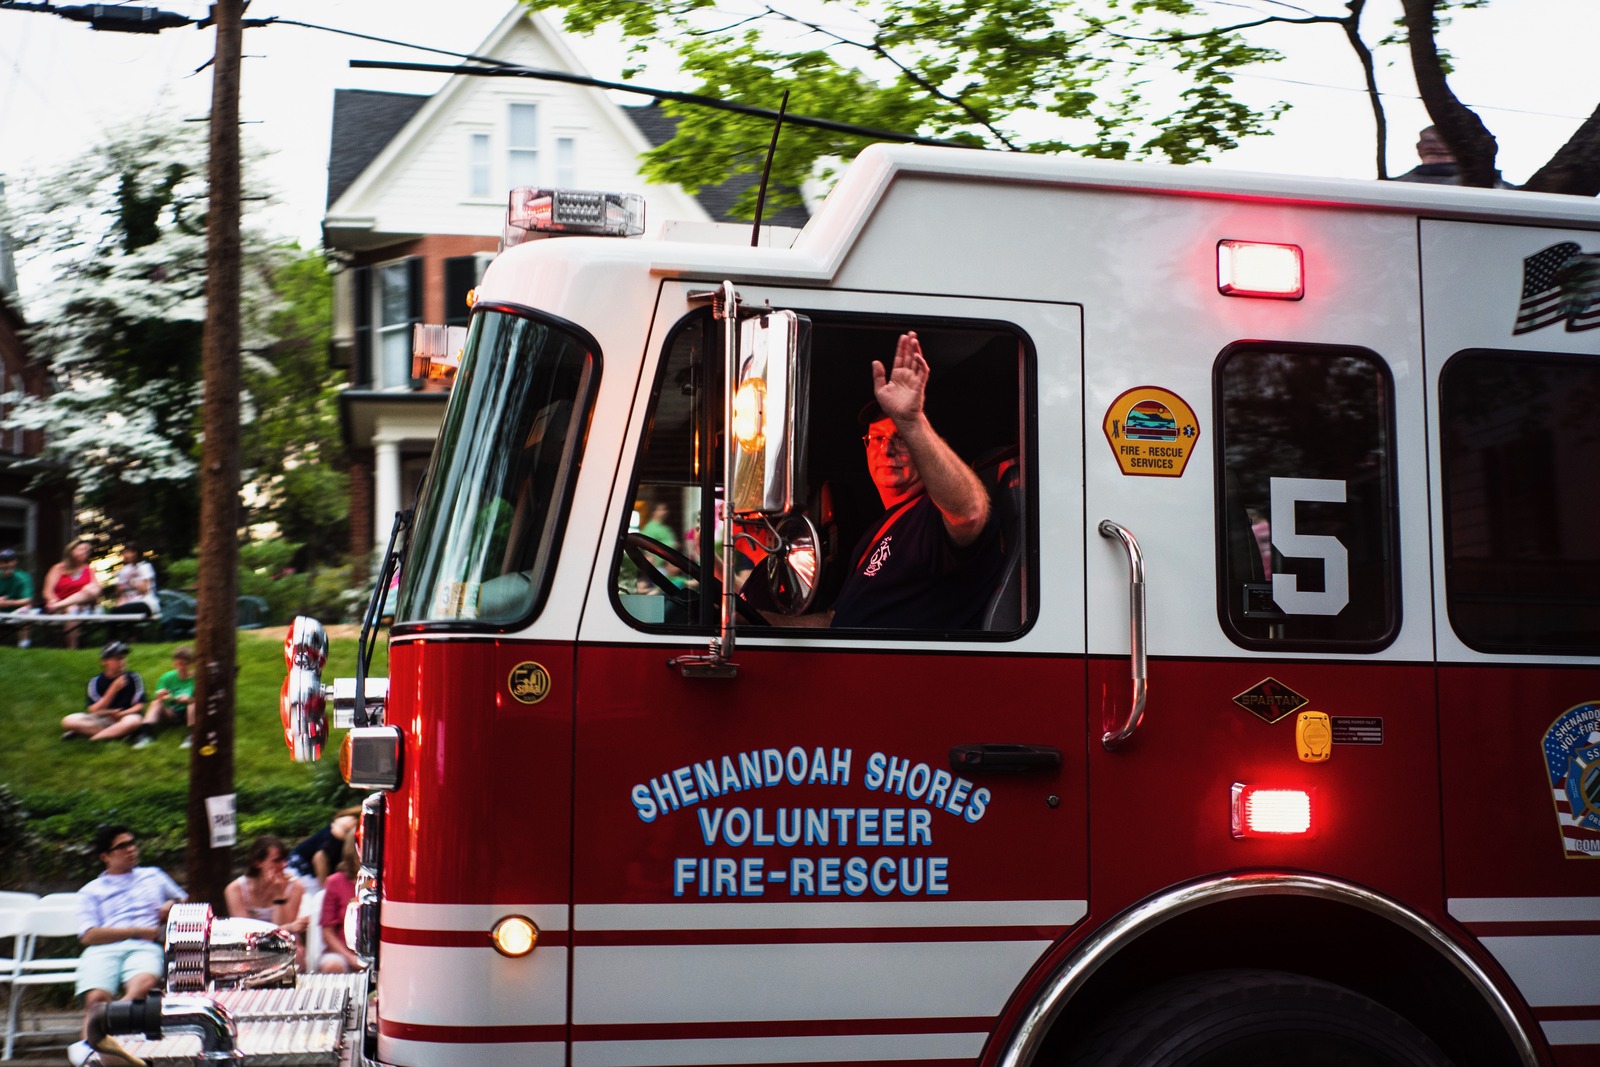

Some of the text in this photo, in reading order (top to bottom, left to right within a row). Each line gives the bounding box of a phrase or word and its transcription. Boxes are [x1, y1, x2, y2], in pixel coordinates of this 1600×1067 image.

[1120, 445, 1140, 456] FIRE
[1148, 446, 1183, 458] RESCUE
[1130, 457, 1174, 469] SERVICES
[1269, 476, 1349, 616] 5
[1241, 694, 1300, 706] SPARTAN
[1579, 721, 1600, 736] FIRE
[631, 745, 991, 823] SHENANDOAH SHORES
[697, 807, 933, 846] VOLUNTEER
[674, 856, 949, 897] FIRE-RESCUE
